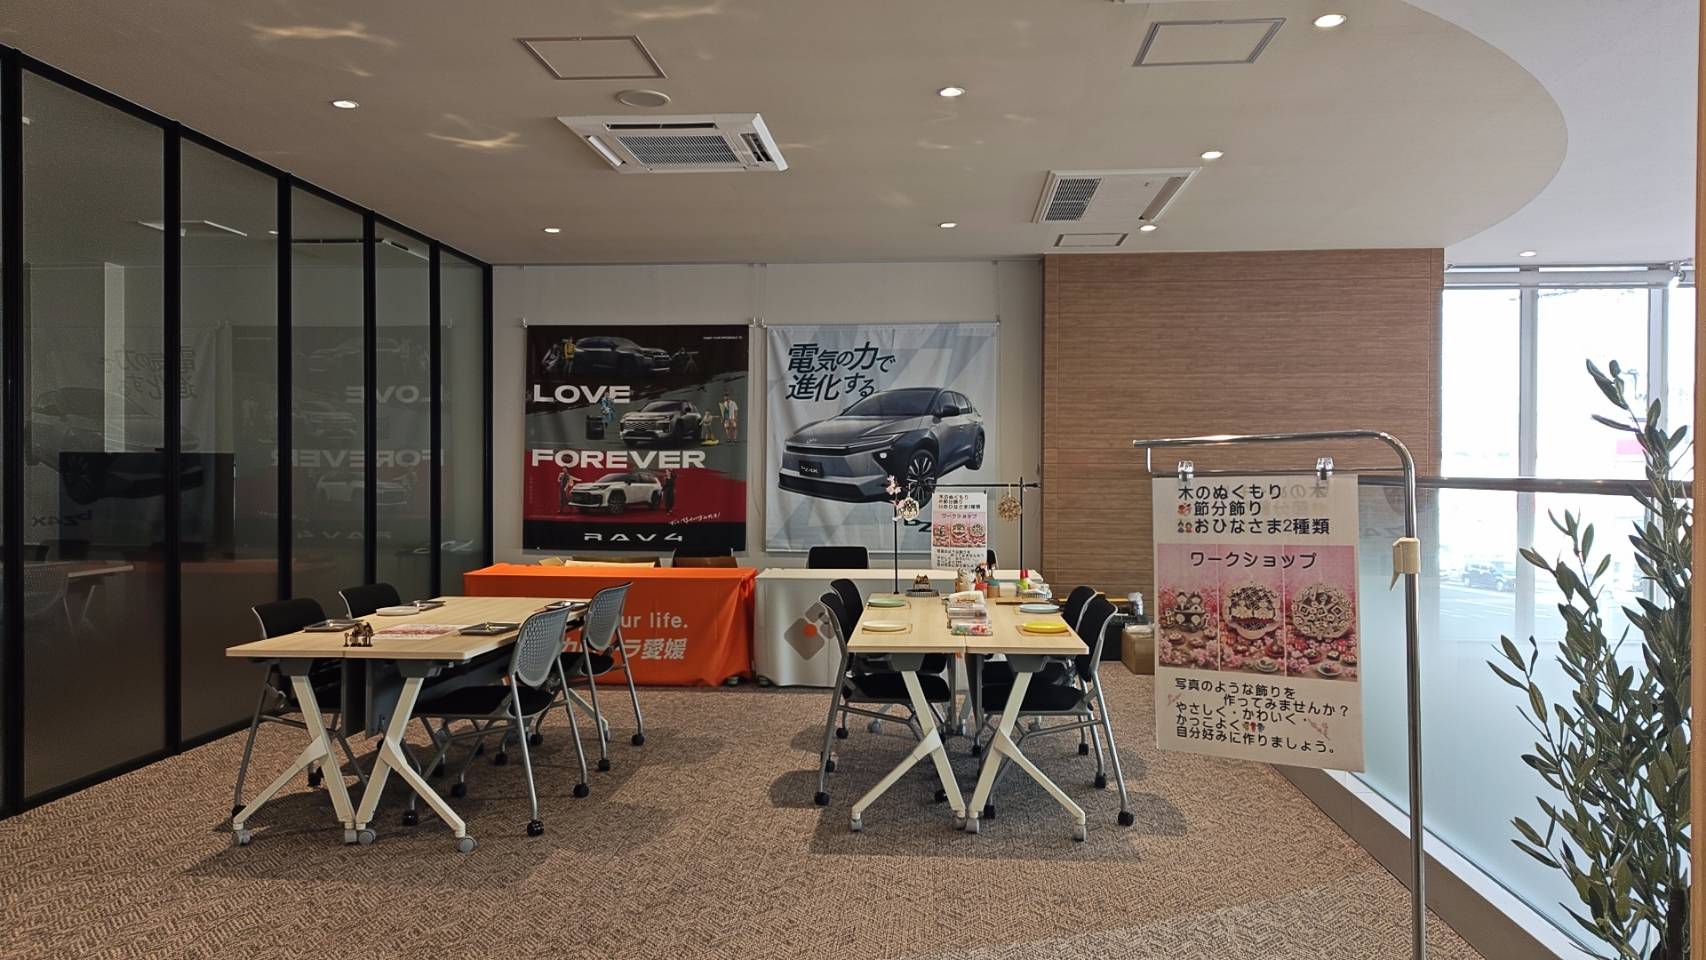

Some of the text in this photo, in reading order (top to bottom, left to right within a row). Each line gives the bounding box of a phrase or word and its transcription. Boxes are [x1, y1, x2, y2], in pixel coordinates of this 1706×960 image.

[787, 341, 896, 374] 電気の力で
[533, 384, 631, 404] LOVE
[785, 374, 876, 402] 進化する
[531, 449, 706, 469] FOREVER
[1178, 484, 1281, 500] 木のぬくもり
[1194, 501, 1261, 516] 節分飾り
[1194, 518, 1330, 534] おひなさま2種類
[584, 532, 683, 542] RAV4
[1190, 551, 1317, 569] ワークショップ
[649, 612, 688, 628] life.
[1175, 678, 1296, 701] 写真のような飾りを
[1176, 713, 1240, 732] かっこよく
[1176, 726, 1335, 755] 自分好みに作りましょう。
